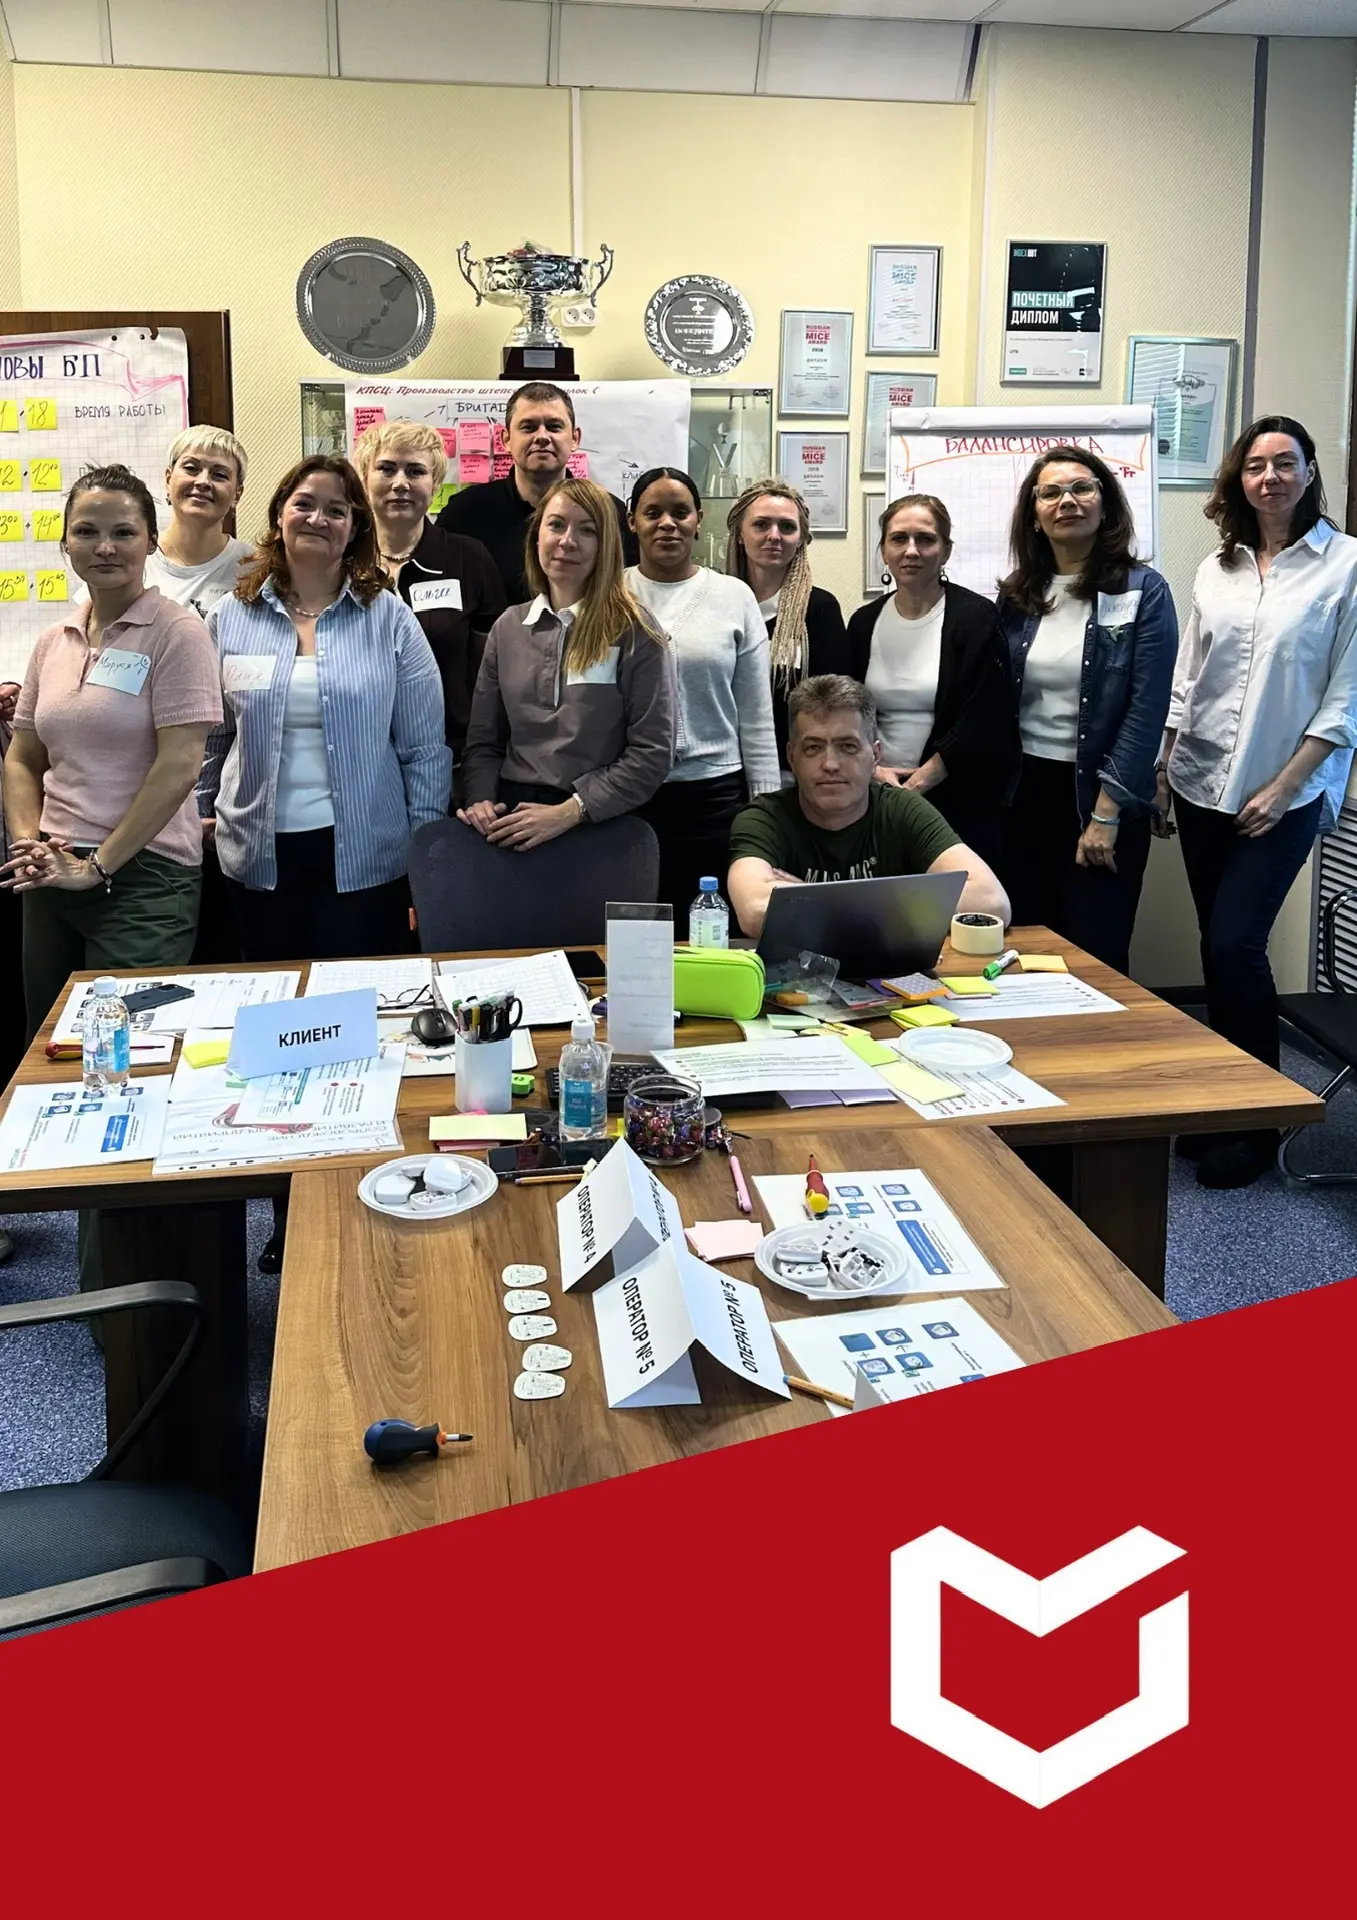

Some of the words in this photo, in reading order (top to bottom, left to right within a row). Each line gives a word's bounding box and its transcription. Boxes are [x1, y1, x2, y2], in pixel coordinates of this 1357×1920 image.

[1012, 292, 1075, 307] ПОЧЕТНЫЙ
[1011, 310, 1059, 325] ДИПЛОМ
[806, 332, 830, 340] MICE
[0, 355, 43, 380] ОВЫ
[356, 385, 394, 396] КПСЦ:
[397, 385, 475, 396] Производство
[889, 394, 912, 402] MICE
[28, 401, 48, 426] 18
[75, 405, 110, 418] ВРЕМЯ
[119, 403, 165, 417] РАБОТЫ
[455, 402, 507, 413] БРИГАД
[945, 436, 1103, 454] БАЛАНСИРОВКА
[279, 1024, 342, 1048] КЛИЕНТ
[577, 1185, 594, 1239] ОПЕРАТОР
[582, 1236, 596, 1252] №
[584, 1251, 596, 1264] 4
[721, 1279, 736, 1291] 5
[723, 1289, 740, 1306] №
[622, 1277, 649, 1342] ОПЕРАТОР
[727, 1304, 759, 1373] ОПЕРАТОР
[635, 1341, 653, 1361] №
[639, 1359, 655, 1375] 5
